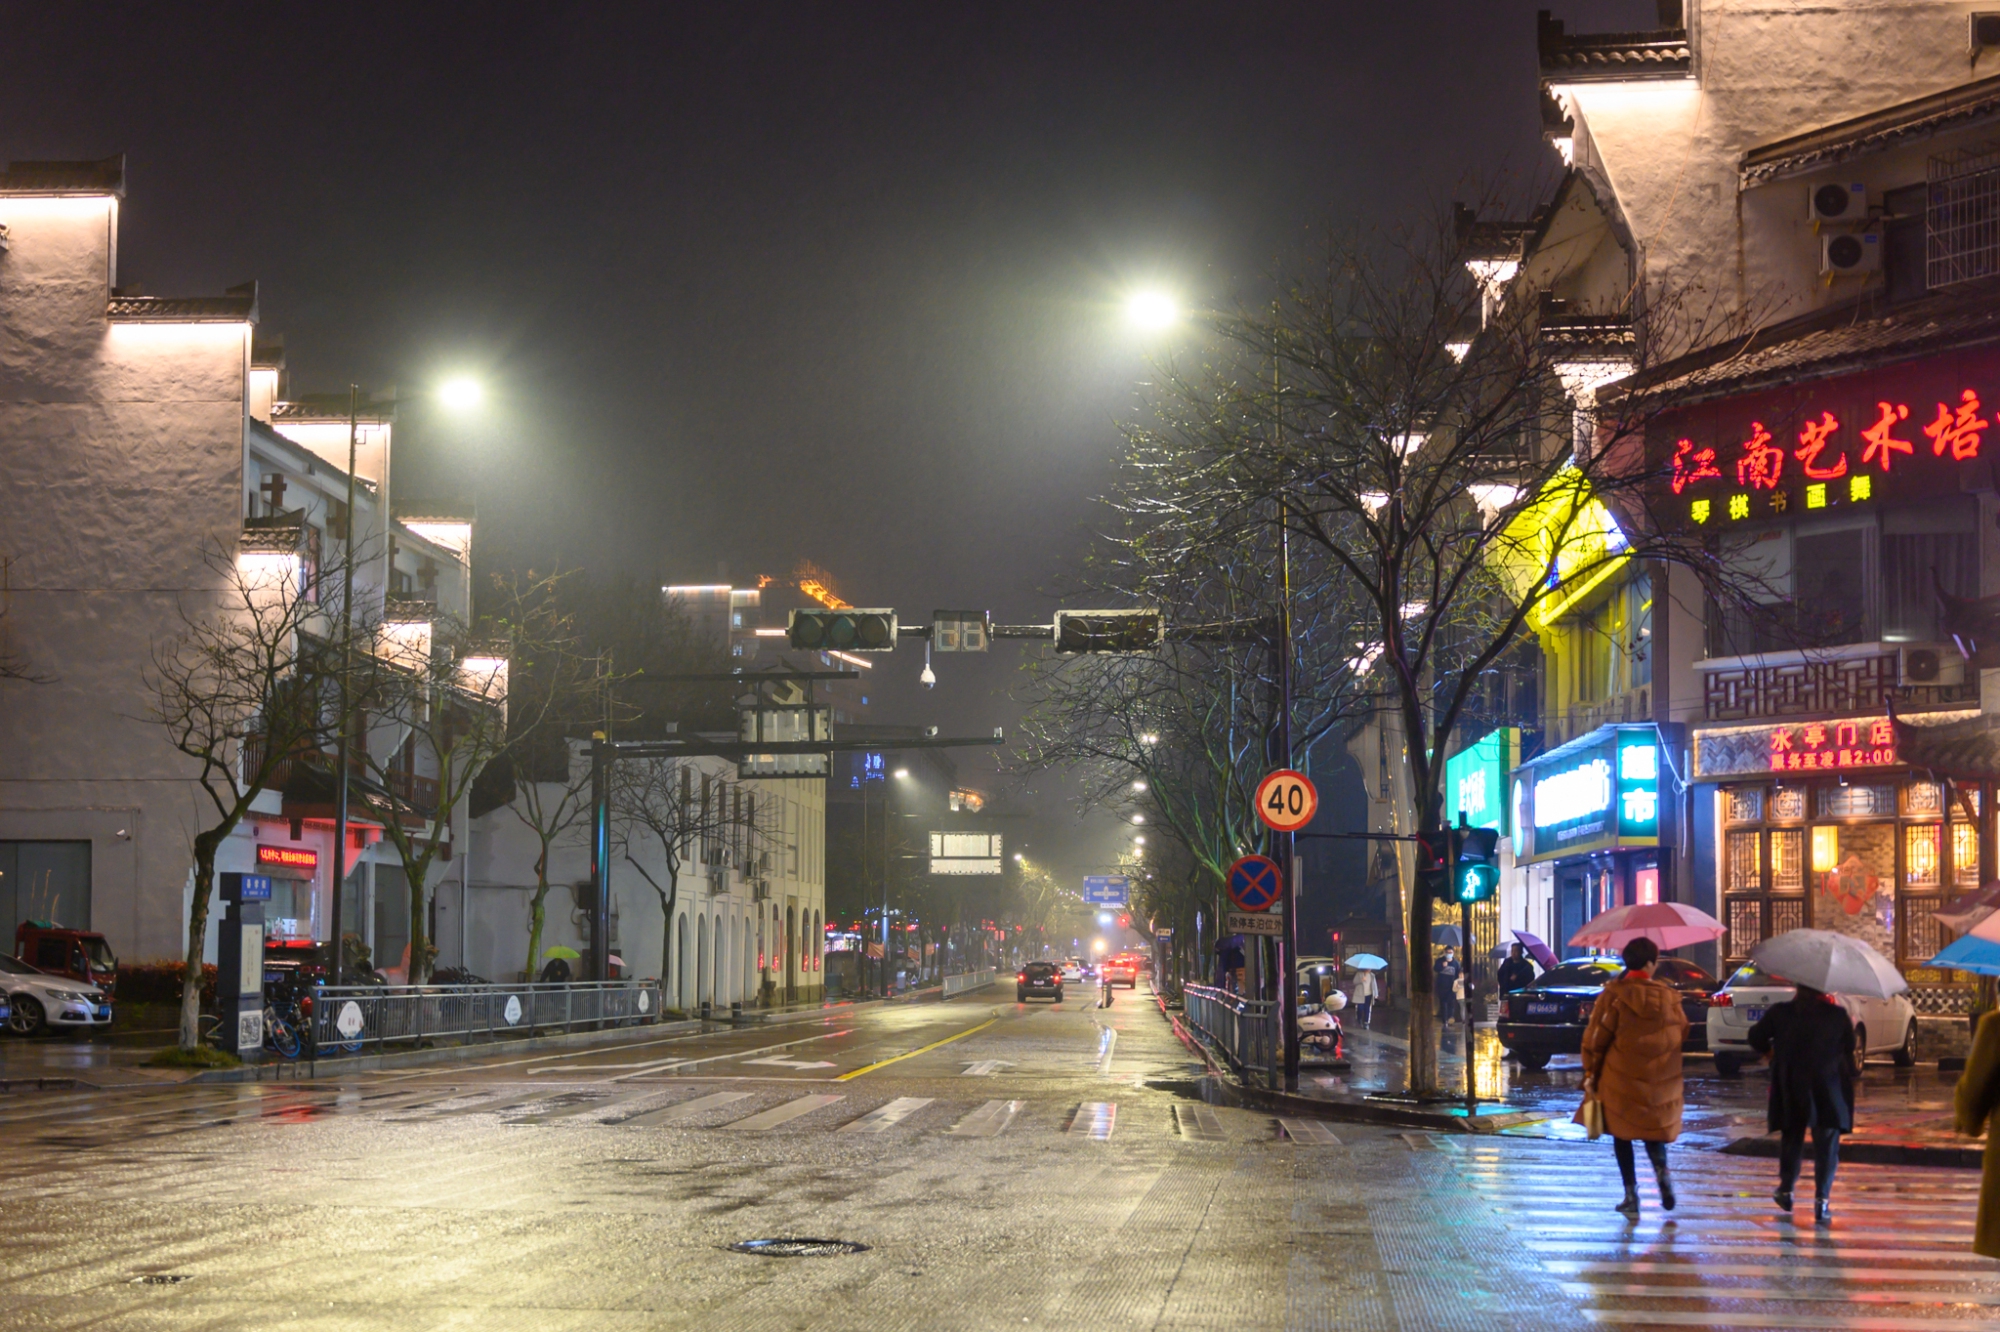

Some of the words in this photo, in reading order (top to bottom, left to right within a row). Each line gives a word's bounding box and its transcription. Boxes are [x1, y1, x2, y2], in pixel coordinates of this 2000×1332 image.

[1671, 389, 2000, 495] 江南艺术培
[1771, 718, 1892, 752] 水亭门店
[1770, 749, 1895, 771] 服务至凌晨2:00
[1268, 784, 1303, 816] 40
[1230, 916, 1283, 931] 除停车泊位外
